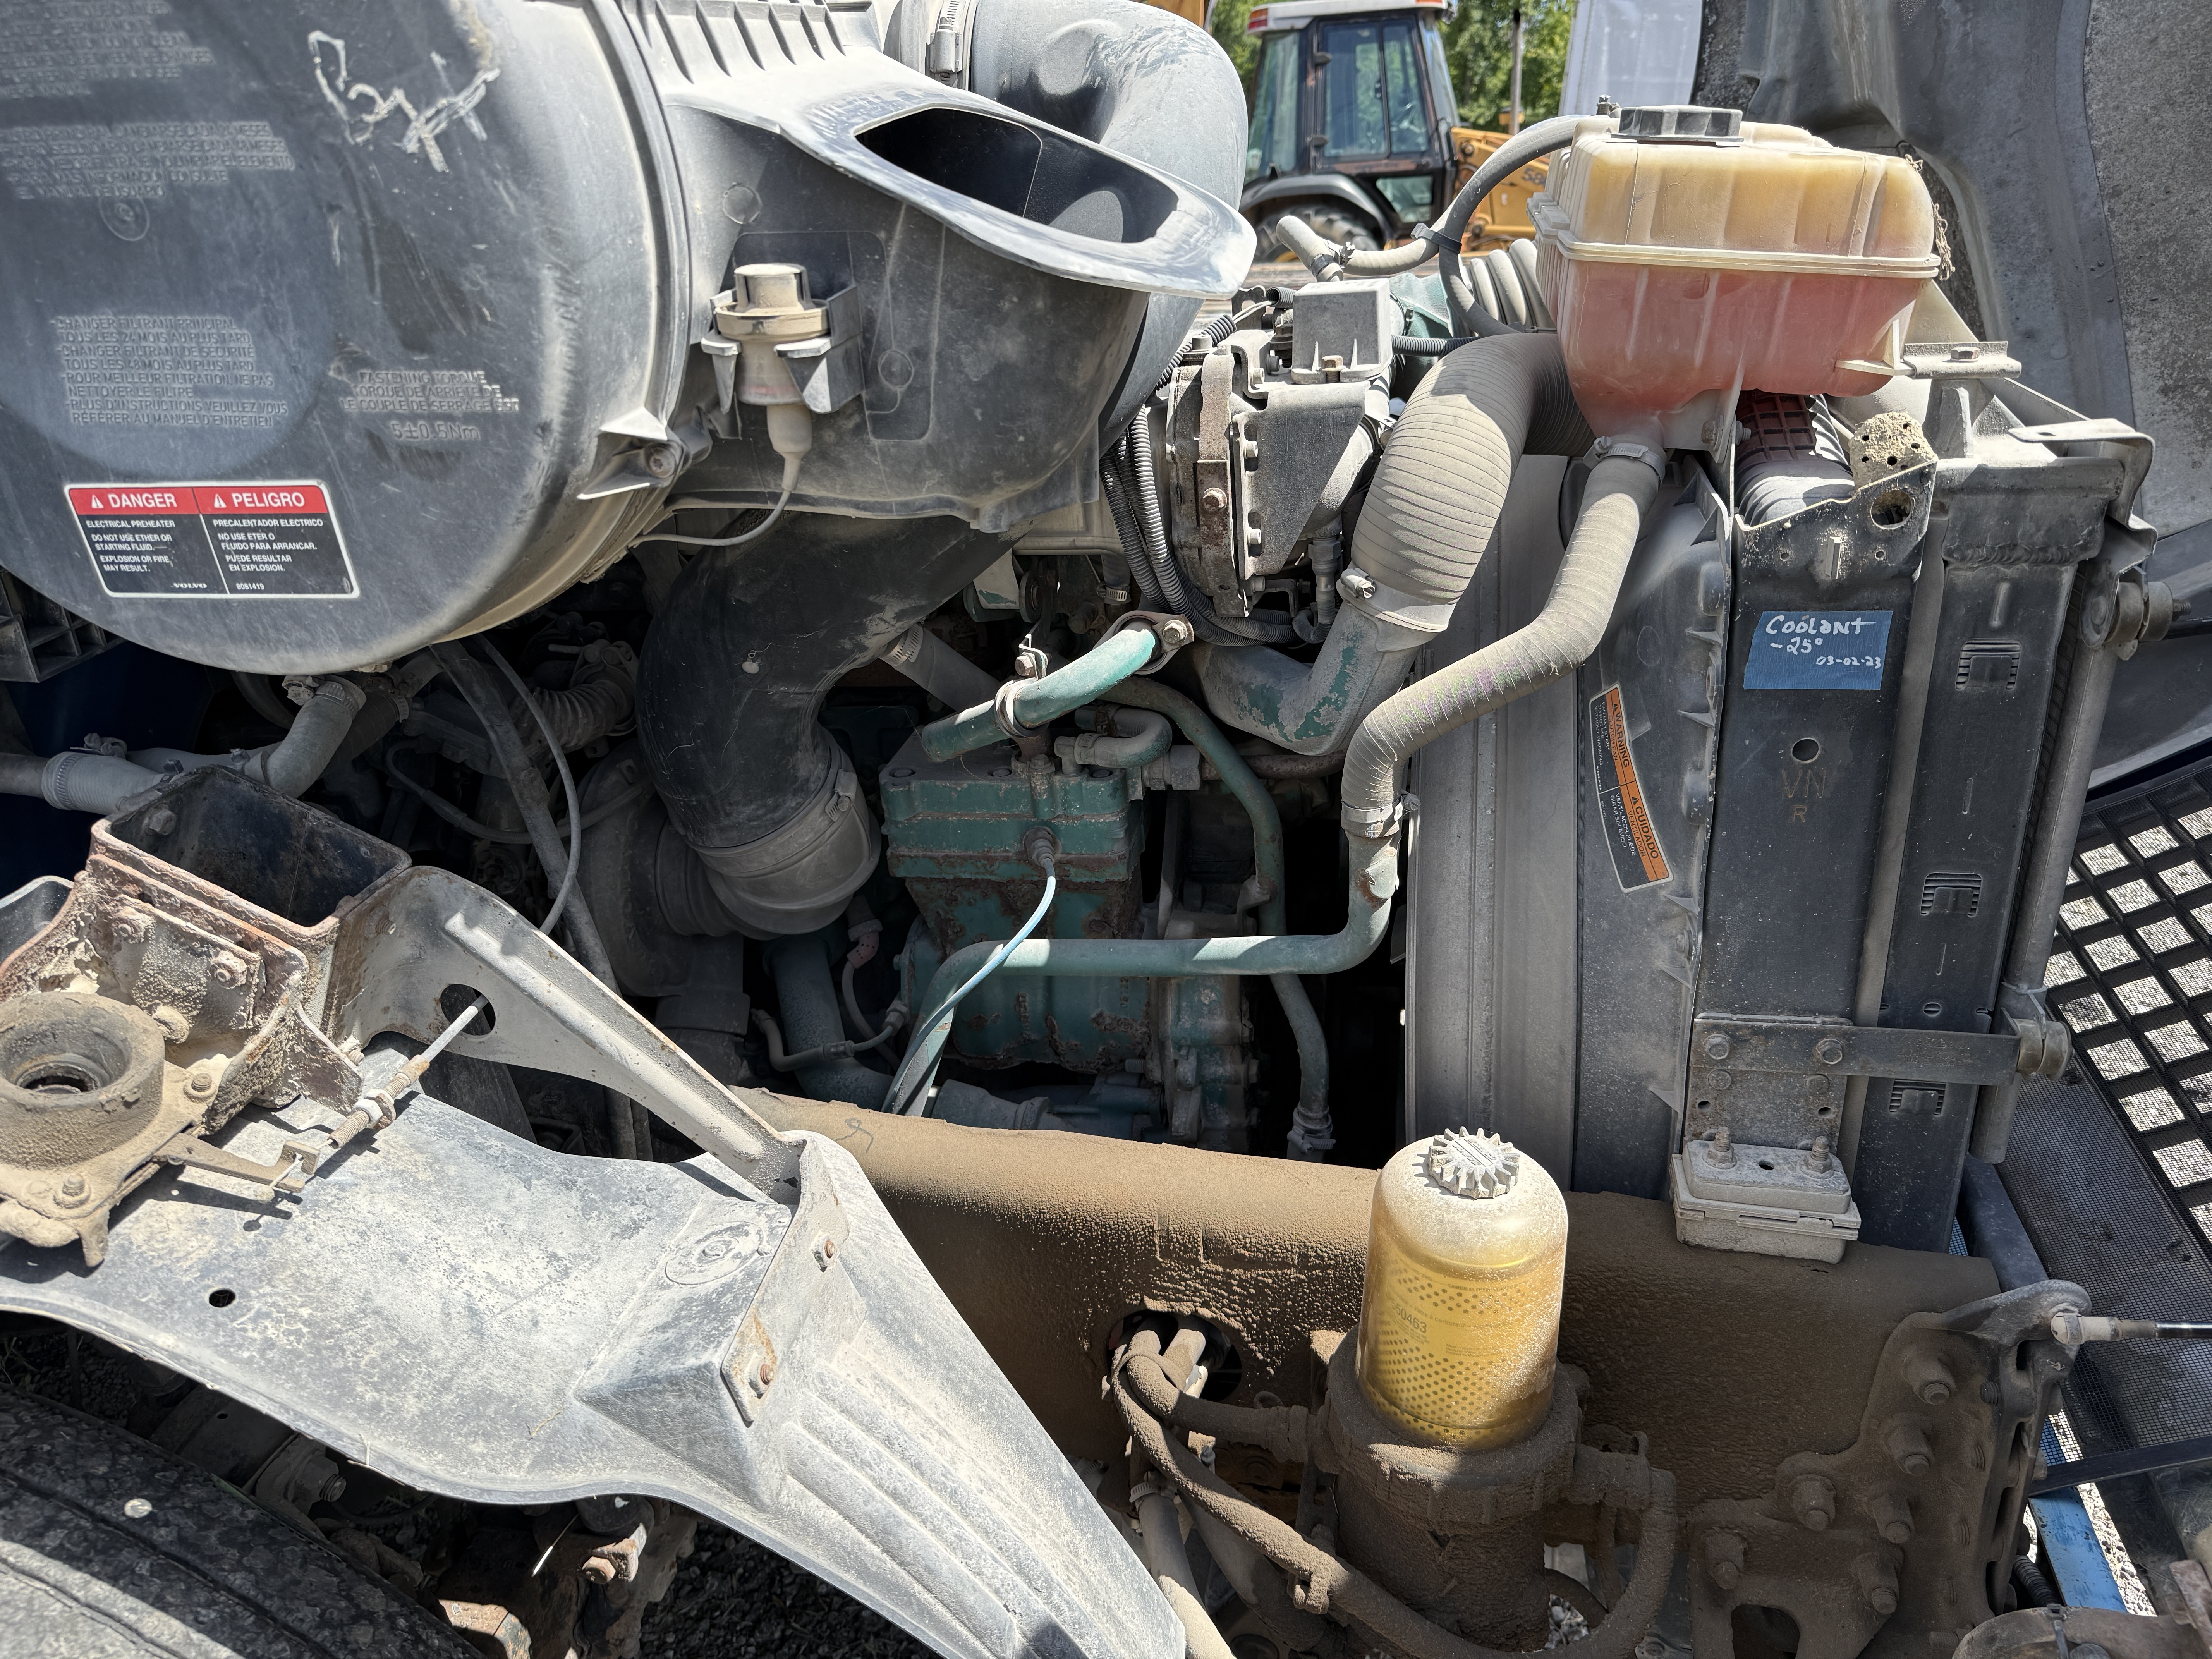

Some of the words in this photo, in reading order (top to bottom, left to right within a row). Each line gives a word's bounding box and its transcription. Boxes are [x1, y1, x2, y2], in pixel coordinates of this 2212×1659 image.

[233, 122, 273, 137] MESES
[250, 137, 288, 152] MESES
[118, 317, 174, 330] FILTRANT
[177, 317, 237, 330] PRINCIPAL
[60, 331, 91, 343] TOUS
[94, 331, 119, 343] LES
[139, 332, 168, 343] MOIS
[172, 332, 187, 343] AU
[189, 332, 218, 344] PLUS
[221, 332, 252, 345] TARD
[124, 345, 181, 358] FILTRANT
[183, 345, 199, 358] DE
[64, 358, 97, 370] TOUS
[100, 358, 124, 370] LES
[145, 359, 173, 371] MOIS
[177, 359, 192, 371] AU
[194, 359, 224, 371] PLUS
[226, 359, 255, 372] TARD
[103, 372, 162, 384] MEILLEUR
[235, 373, 251, 385] NE
[252, 374, 274, 386] PAS
[359, 371, 431, 384] FASTENING
[432, 371, 487, 383] TORQUE
[68, 385, 134, 397] NETTOYER
[137, 386, 152, 397] LE
[153, 386, 194, 398] FILTRE
[405, 385, 424, 397] DE
[425, 385, 482, 398] APRIETE
[483, 385, 503, 398] DE
[205, 401, 258, 413] VEUILLEZ
[259, 402, 288, 414] VOUS
[340, 398, 356, 410] LE
[359, 398, 409, 411] COUPLE
[410, 399, 428, 411] DE
[429, 399, 493, 412] SERRAGE
[493, 398, 520, 412] EST
[134, 413, 149, 424] AU
[152, 413, 201, 425] MANUEL
[203, 414, 273, 427] D'ENTRETIEN
[107, 493, 178, 508] DANGER
[232, 492, 305, 508] PELIGRO
[86, 519, 131, 528] ELECTRICAL
[131, 519, 176, 528] PREHEATER
[213, 519, 280, 528] PRECALENTADOR
[280, 518, 324, 527] ELECTRICO
[91, 533, 103, 541] DO
[103, 533, 118, 541] NOT
[119, 533, 135, 541] USE
[135, 533, 160, 541] ETHER
[160, 533, 173, 541] OR
[217, 532, 230, 541] NO
[231, 532, 247, 541] USE
[247, 532, 267, 541] ETER
[268, 532, 275, 541] O
[249, 542, 271, 550] PARA
[272, 542, 318, 550] ARRANCAR.
[100, 555, 140, 563] EXPLOSION
[140, 555, 152, 563] OR
[153, 555, 169, 563] FIRE
[225, 554, 252, 563] PUEDE
[252, 554, 292, 563] RESULTAR
[120, 564, 151, 572] RESULT.
[241, 564, 286, 572] EXPLOSION.
[1615, 712, 1630, 768] WARNING
[1781, 769, 1827, 799] VN
[1610, 795, 1618, 815] GIRAR
[1793, 804, 1807, 824] R
[1615, 793, 1629, 833] VENTILADOR
[1626, 834, 1637, 856] PUEDE
[1628, 810, 1646, 857] VENTILADOR
[1635, 806, 1659, 859] CUIDADO
